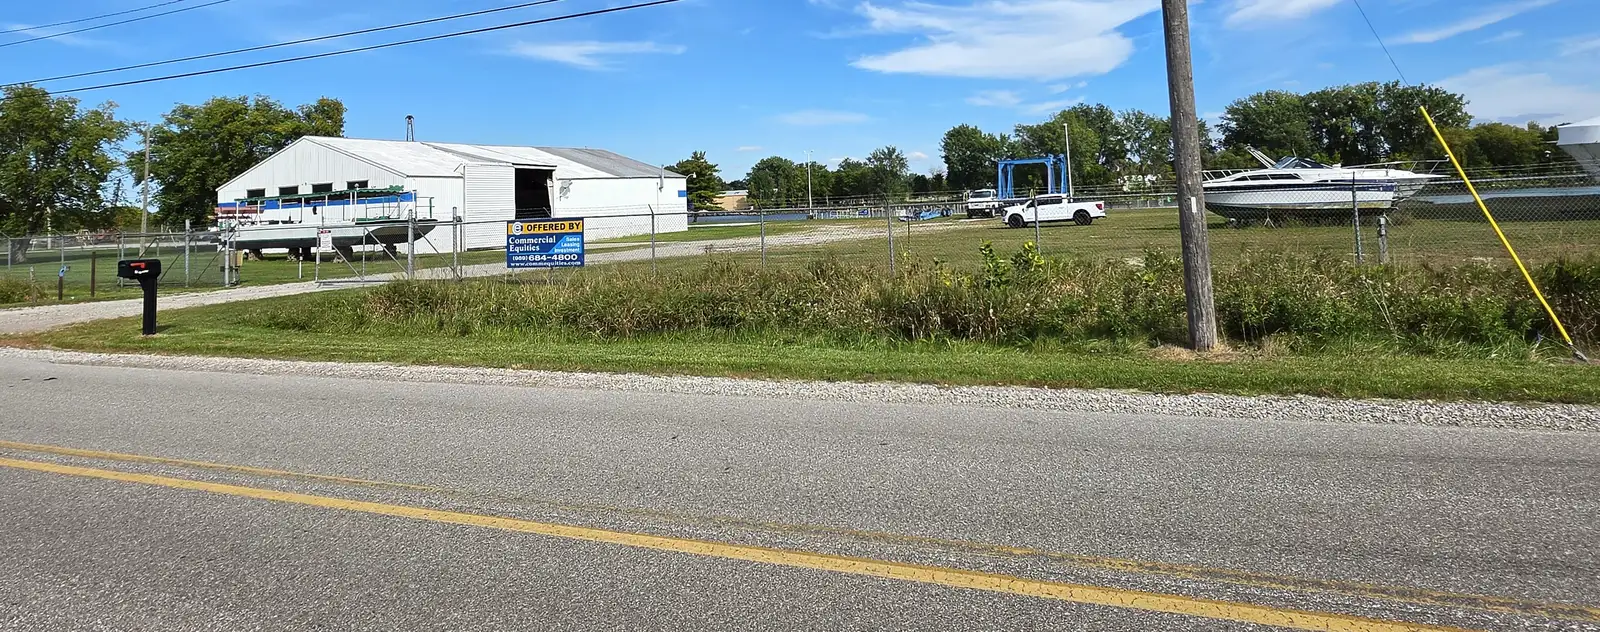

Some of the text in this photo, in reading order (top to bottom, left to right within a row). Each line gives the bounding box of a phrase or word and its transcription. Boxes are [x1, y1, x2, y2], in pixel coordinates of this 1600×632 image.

[526, 223, 566, 231] OFFERED
[509, 236, 556, 244] Commercial
[510, 244, 540, 253] Equities
